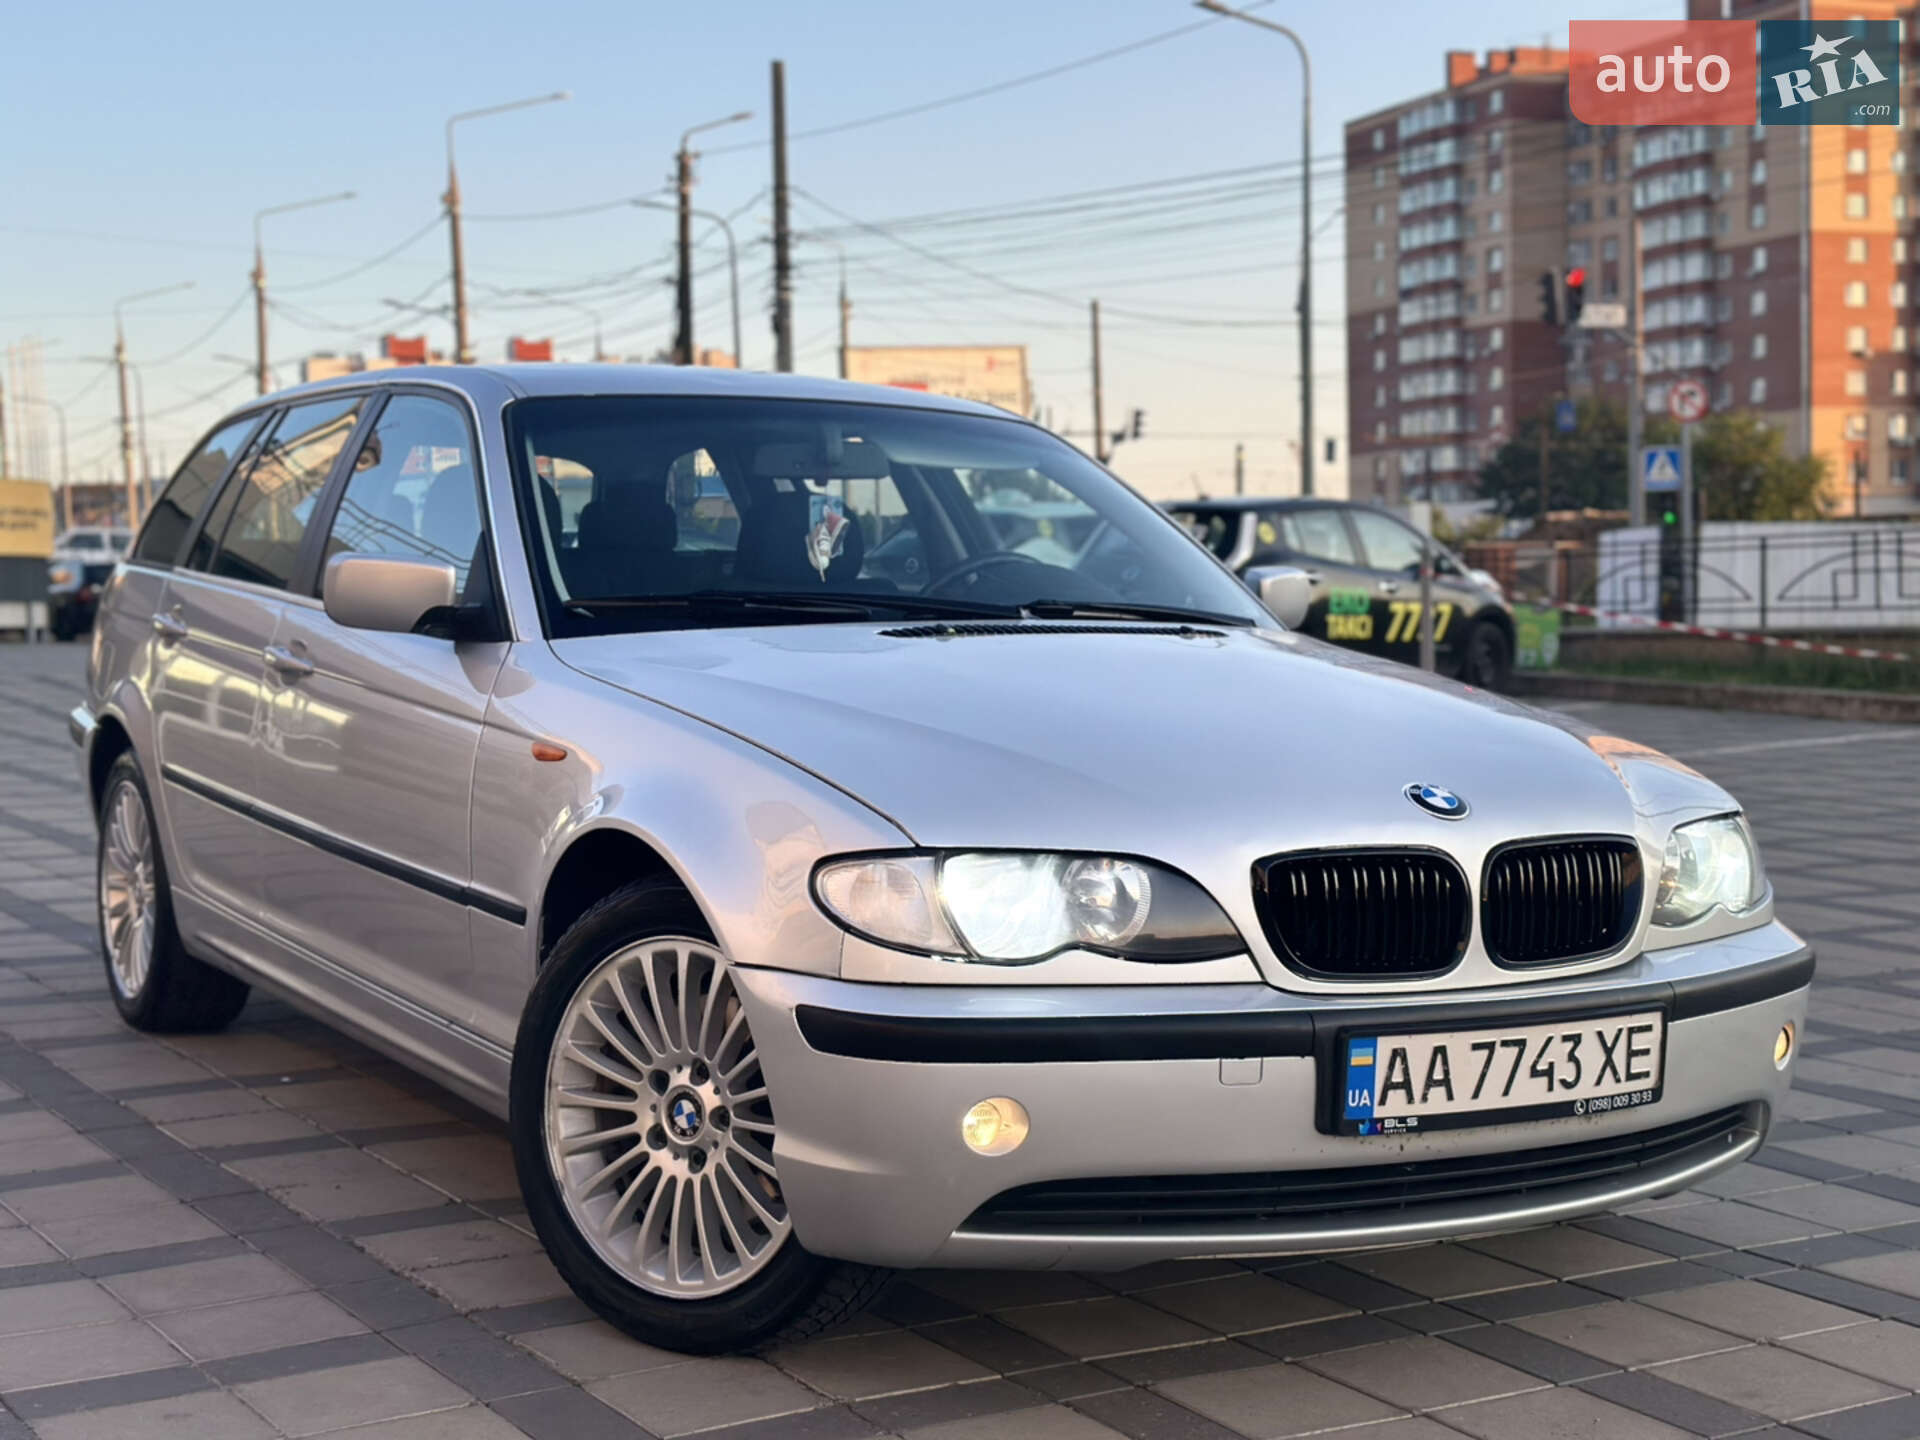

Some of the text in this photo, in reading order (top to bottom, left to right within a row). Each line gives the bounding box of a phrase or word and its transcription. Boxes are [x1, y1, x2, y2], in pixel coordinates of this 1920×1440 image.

[1384, 600, 1454, 643] 777
[1377, 1023, 1655, 1106] AA 7743 XE
[1348, 1089, 1370, 1107] UA
[1384, 1117, 1418, 1127] BLS
